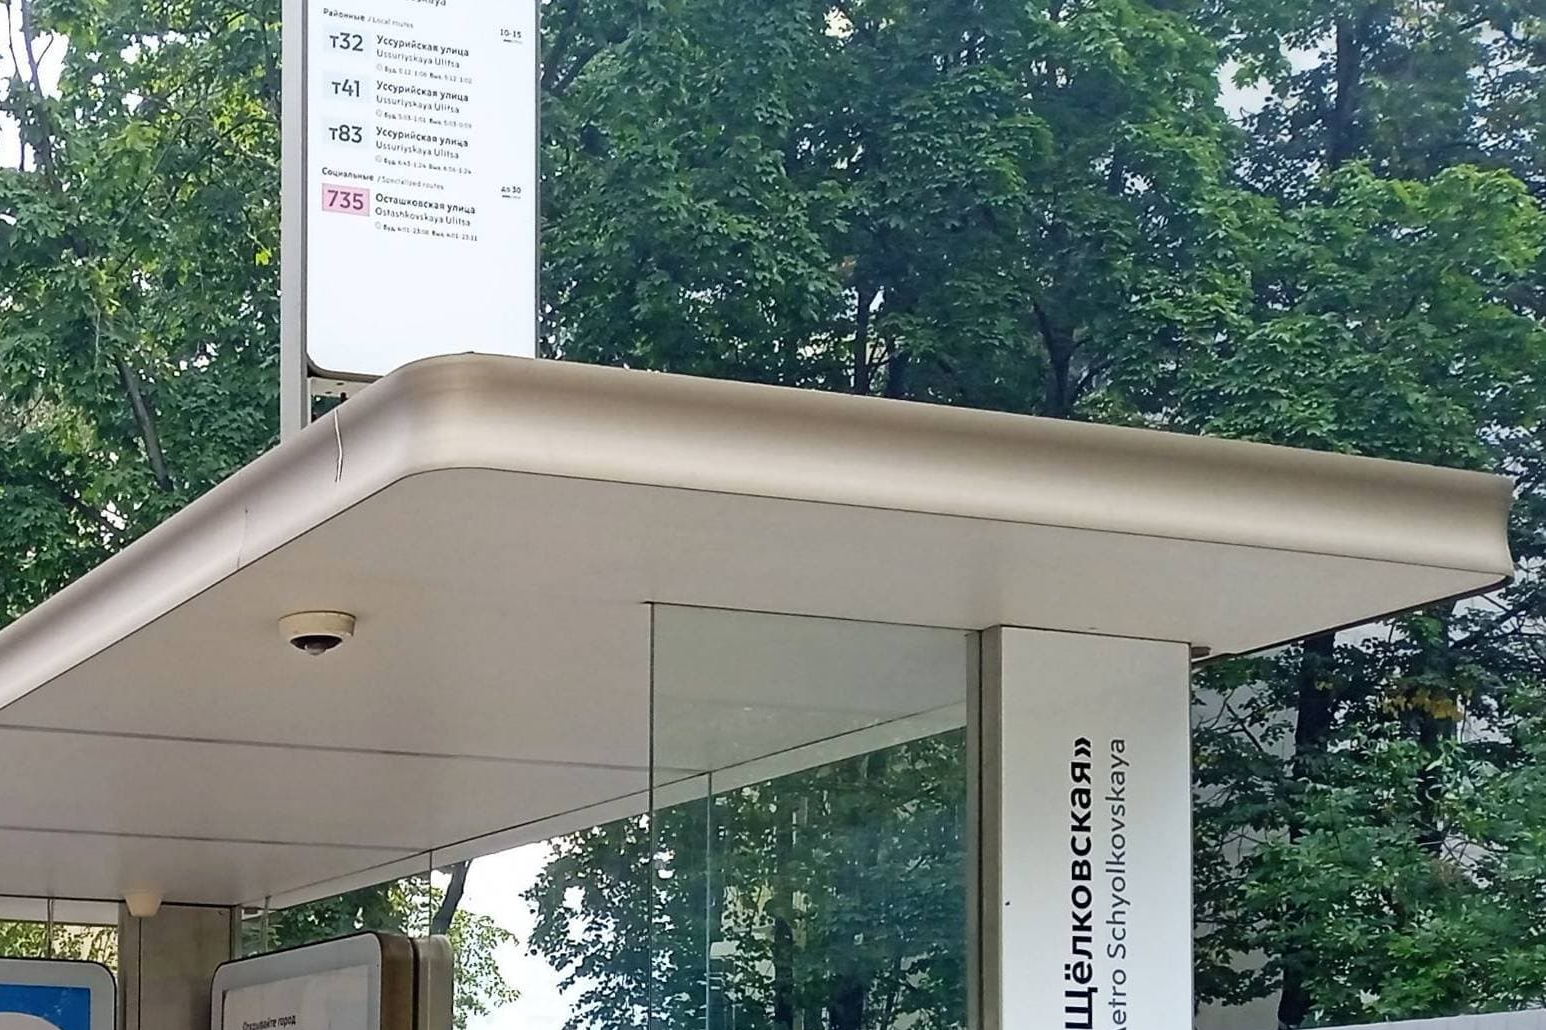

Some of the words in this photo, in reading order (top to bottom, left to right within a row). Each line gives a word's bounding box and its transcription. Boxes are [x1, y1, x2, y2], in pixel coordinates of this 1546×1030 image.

[329, 32, 364, 52] т32
[376, 34, 438, 52] Уссурийская
[440, 46, 470, 57] улица
[376, 49, 433, 65] Ussuriyskaya
[434, 56, 460, 69] Ulitsa
[331, 79, 361, 98] т41
[376, 80, 438, 98] Уссурийская
[439, 91, 469, 103] улица
[376, 94, 432, 110] Ussuriyskaya
[434, 102, 460, 114] Ulitsa
[329, 124, 363, 143] т83
[376, 126, 437, 143] Уссурийская
[439, 137, 469, 149] улица
[375, 140, 432, 157] Ussuriyskaya
[434, 148, 460, 160] Ulitsa
[322, 166, 374, 182] Социальные
[327, 189, 365, 211] 735
[375, 193, 445, 210] Осташковская
[447, 202, 476, 215] улица
[375, 206, 444, 224] Ostashkovskaya
[445, 215, 471, 227] Ulitsa
[1104, 738, 1131, 959] Schyolkovskaya
